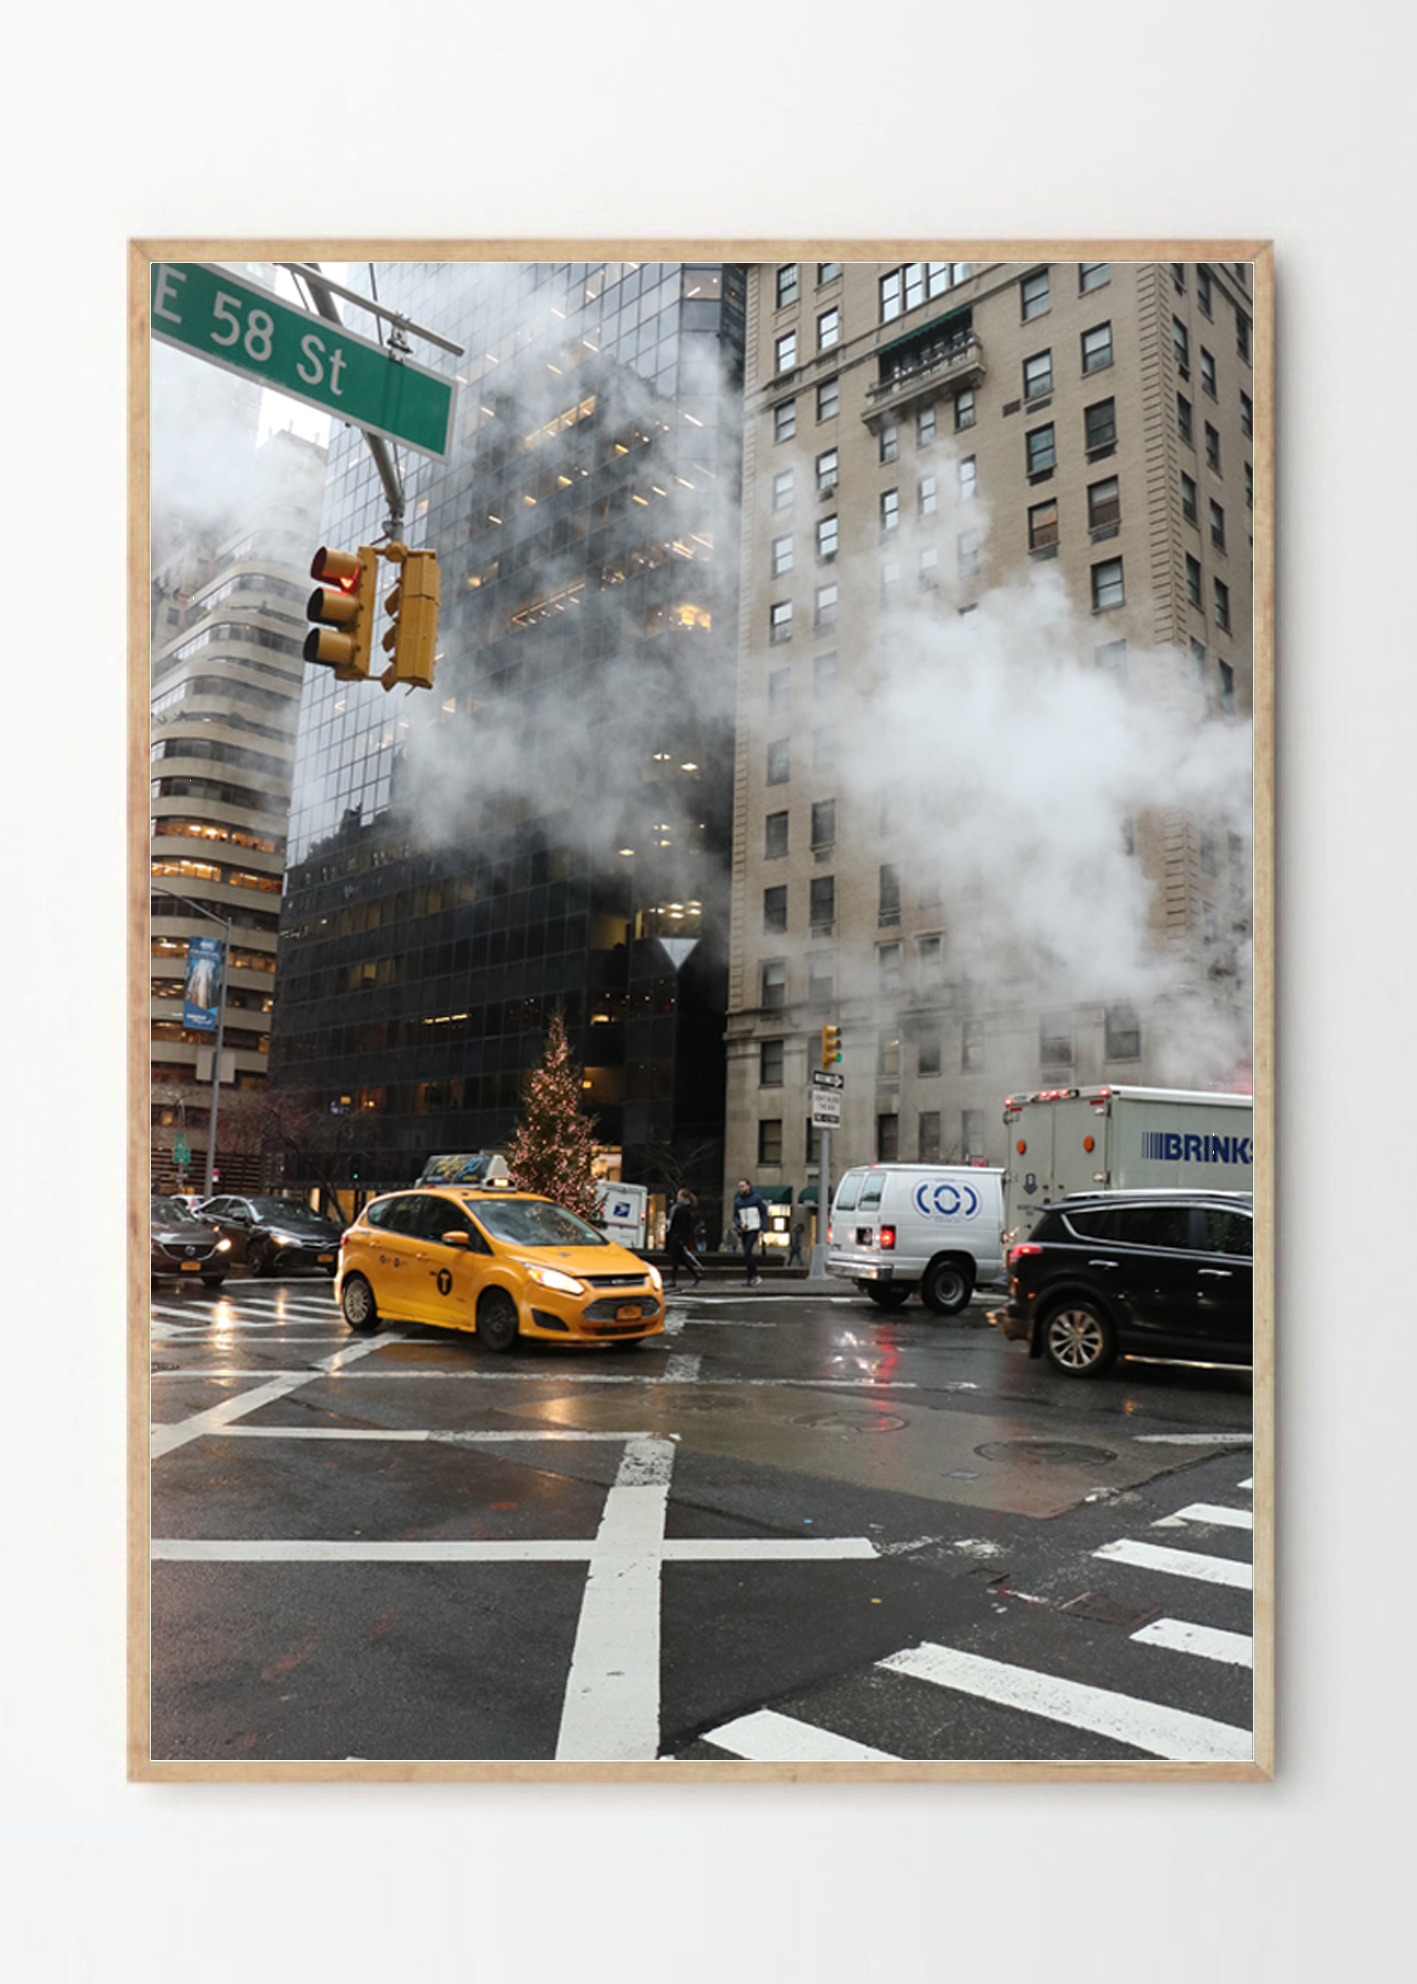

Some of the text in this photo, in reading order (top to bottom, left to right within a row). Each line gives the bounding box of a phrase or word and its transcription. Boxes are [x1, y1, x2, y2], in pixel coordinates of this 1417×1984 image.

[153, 265, 347, 396] E 58 St
[1164, 1132, 1253, 1164] BRINK
